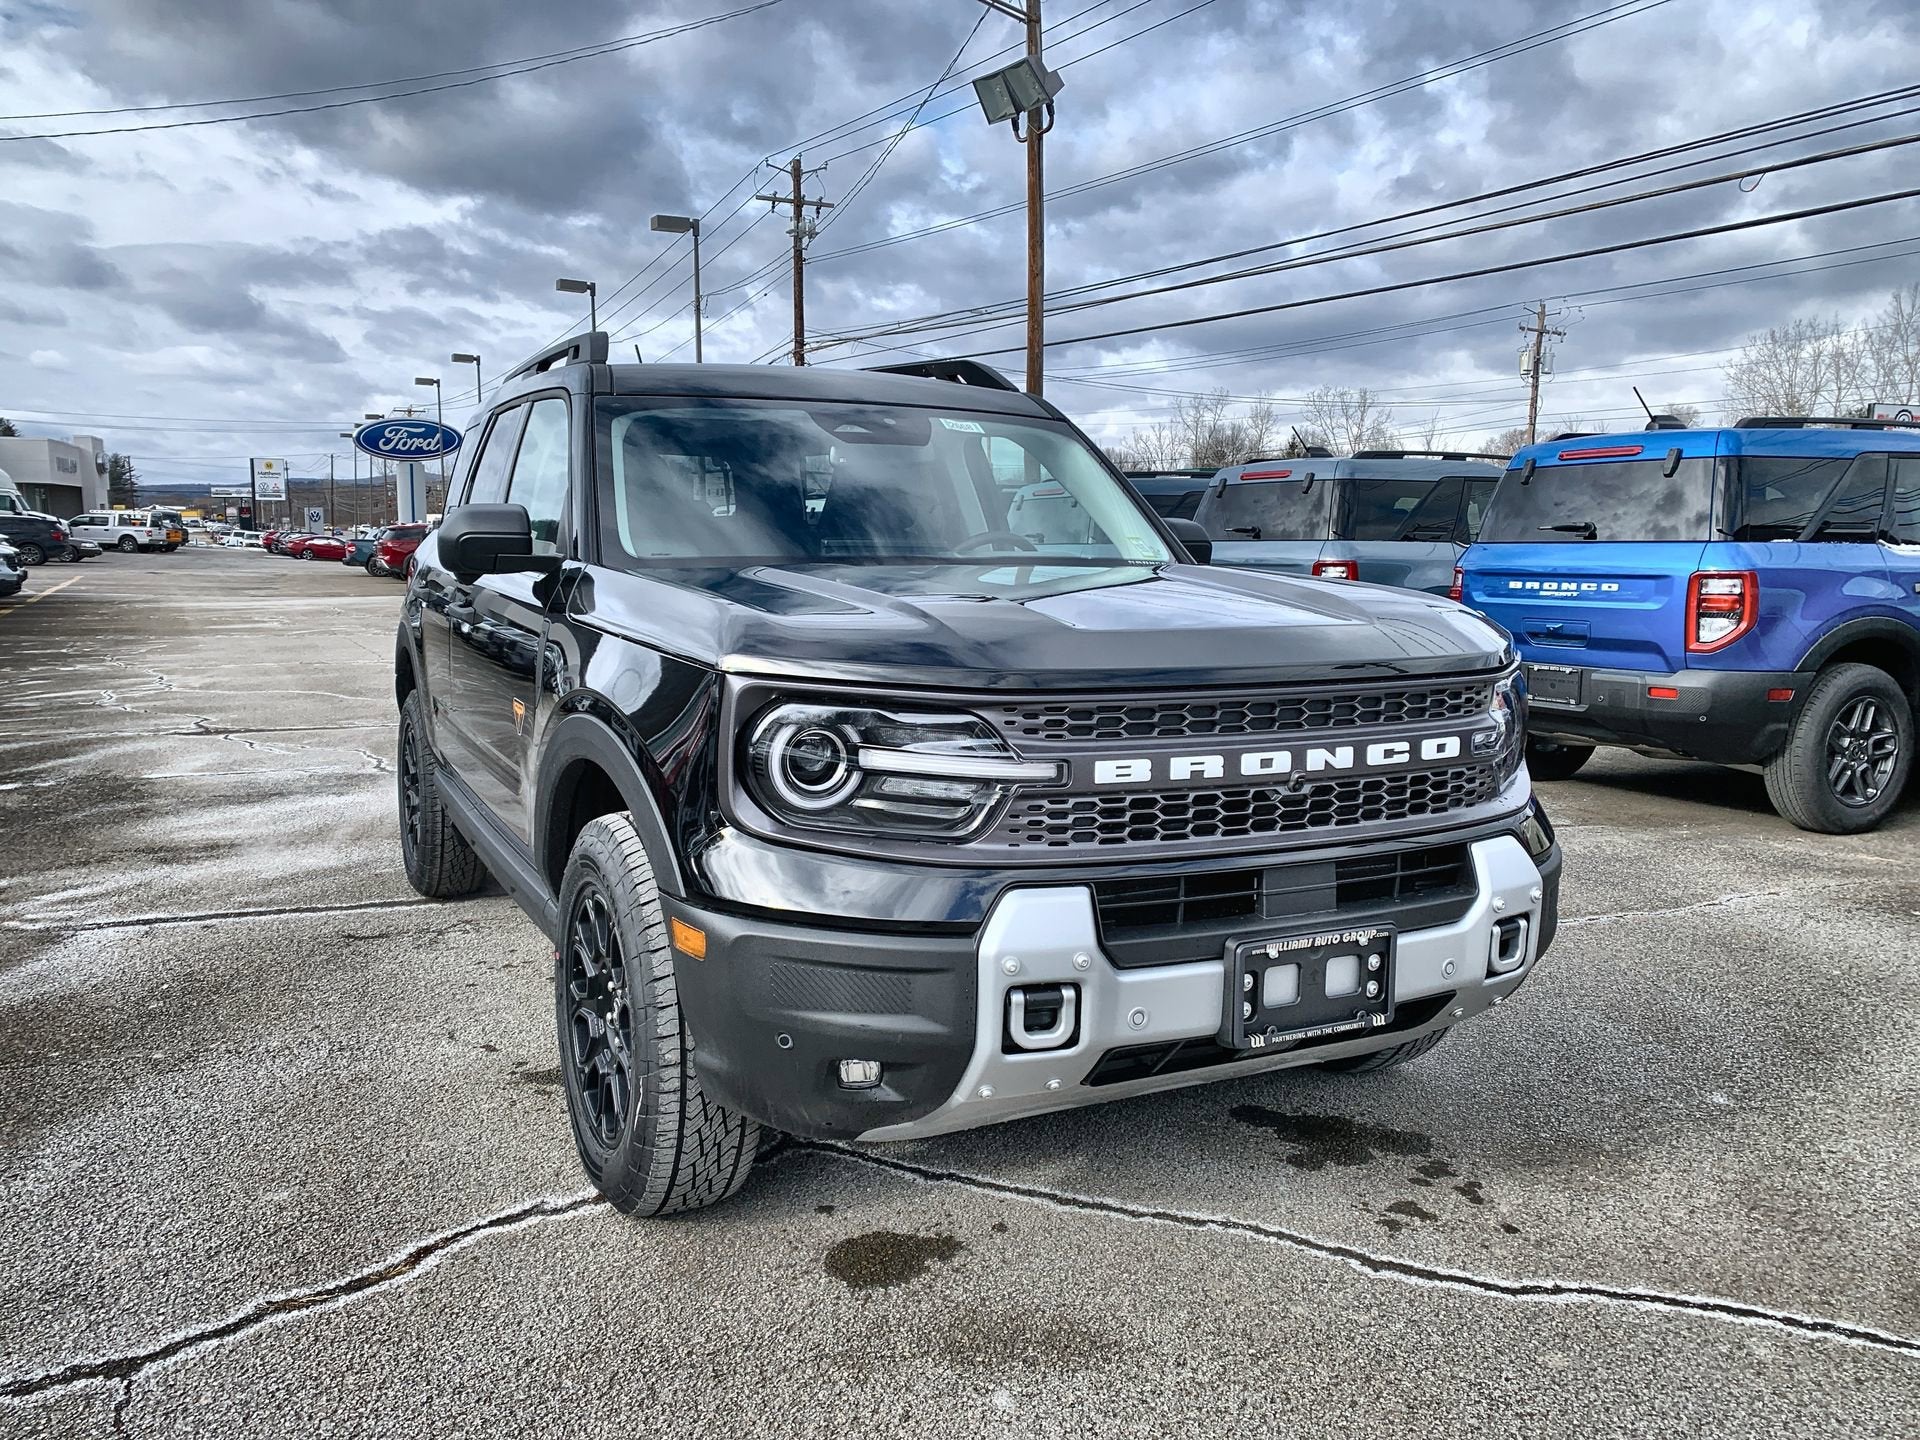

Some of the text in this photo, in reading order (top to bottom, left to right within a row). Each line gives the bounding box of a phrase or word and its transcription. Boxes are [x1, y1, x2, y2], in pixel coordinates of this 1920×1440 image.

[378, 426, 441, 451] Ford
[1509, 580, 1620, 592] BRONCO
[1094, 736, 1461, 784] BRONCO
[1314, 934, 1340, 947] AUTO
[1271, 1021, 1366, 1044] PARTNERING WITH THE COMMUNITY
